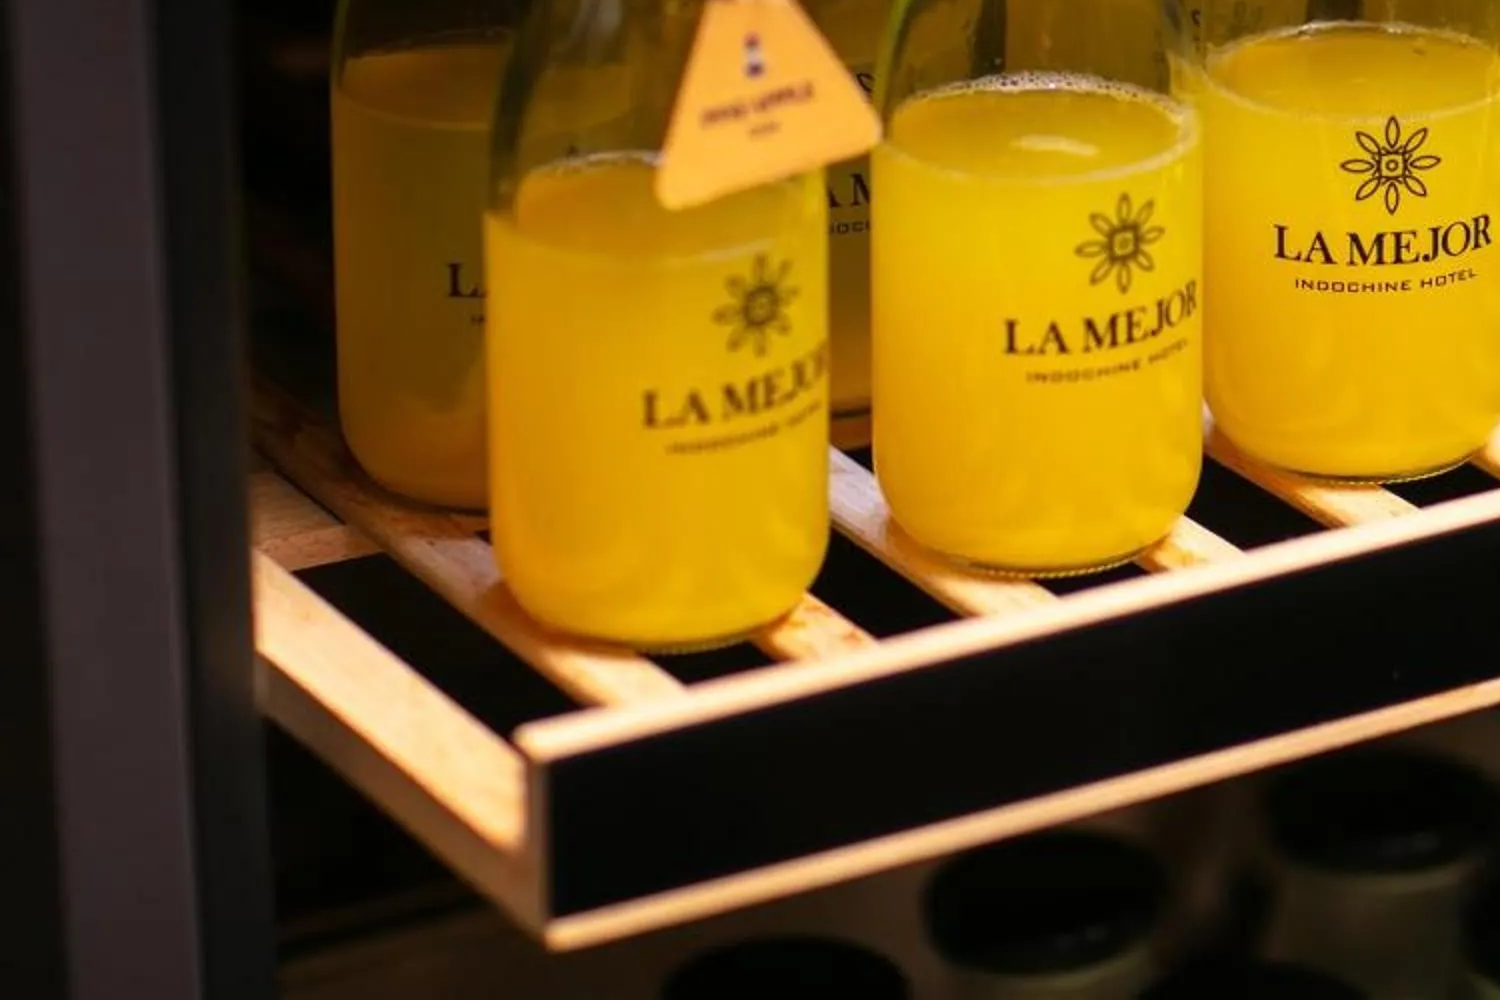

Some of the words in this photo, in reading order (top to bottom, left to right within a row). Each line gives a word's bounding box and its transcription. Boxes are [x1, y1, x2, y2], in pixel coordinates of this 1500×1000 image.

[1273, 223, 1337, 267] LA
[1346, 213, 1493, 267] MEJOR
[447, 262, 484, 298] L
[1295, 278, 1412, 293] INDOCHINE
[1420, 267, 1478, 289] HOTEL
[1003, 317, 1071, 355] LA
[1082, 279, 1198, 354] MEJOR
[643, 387, 710, 429] LA
